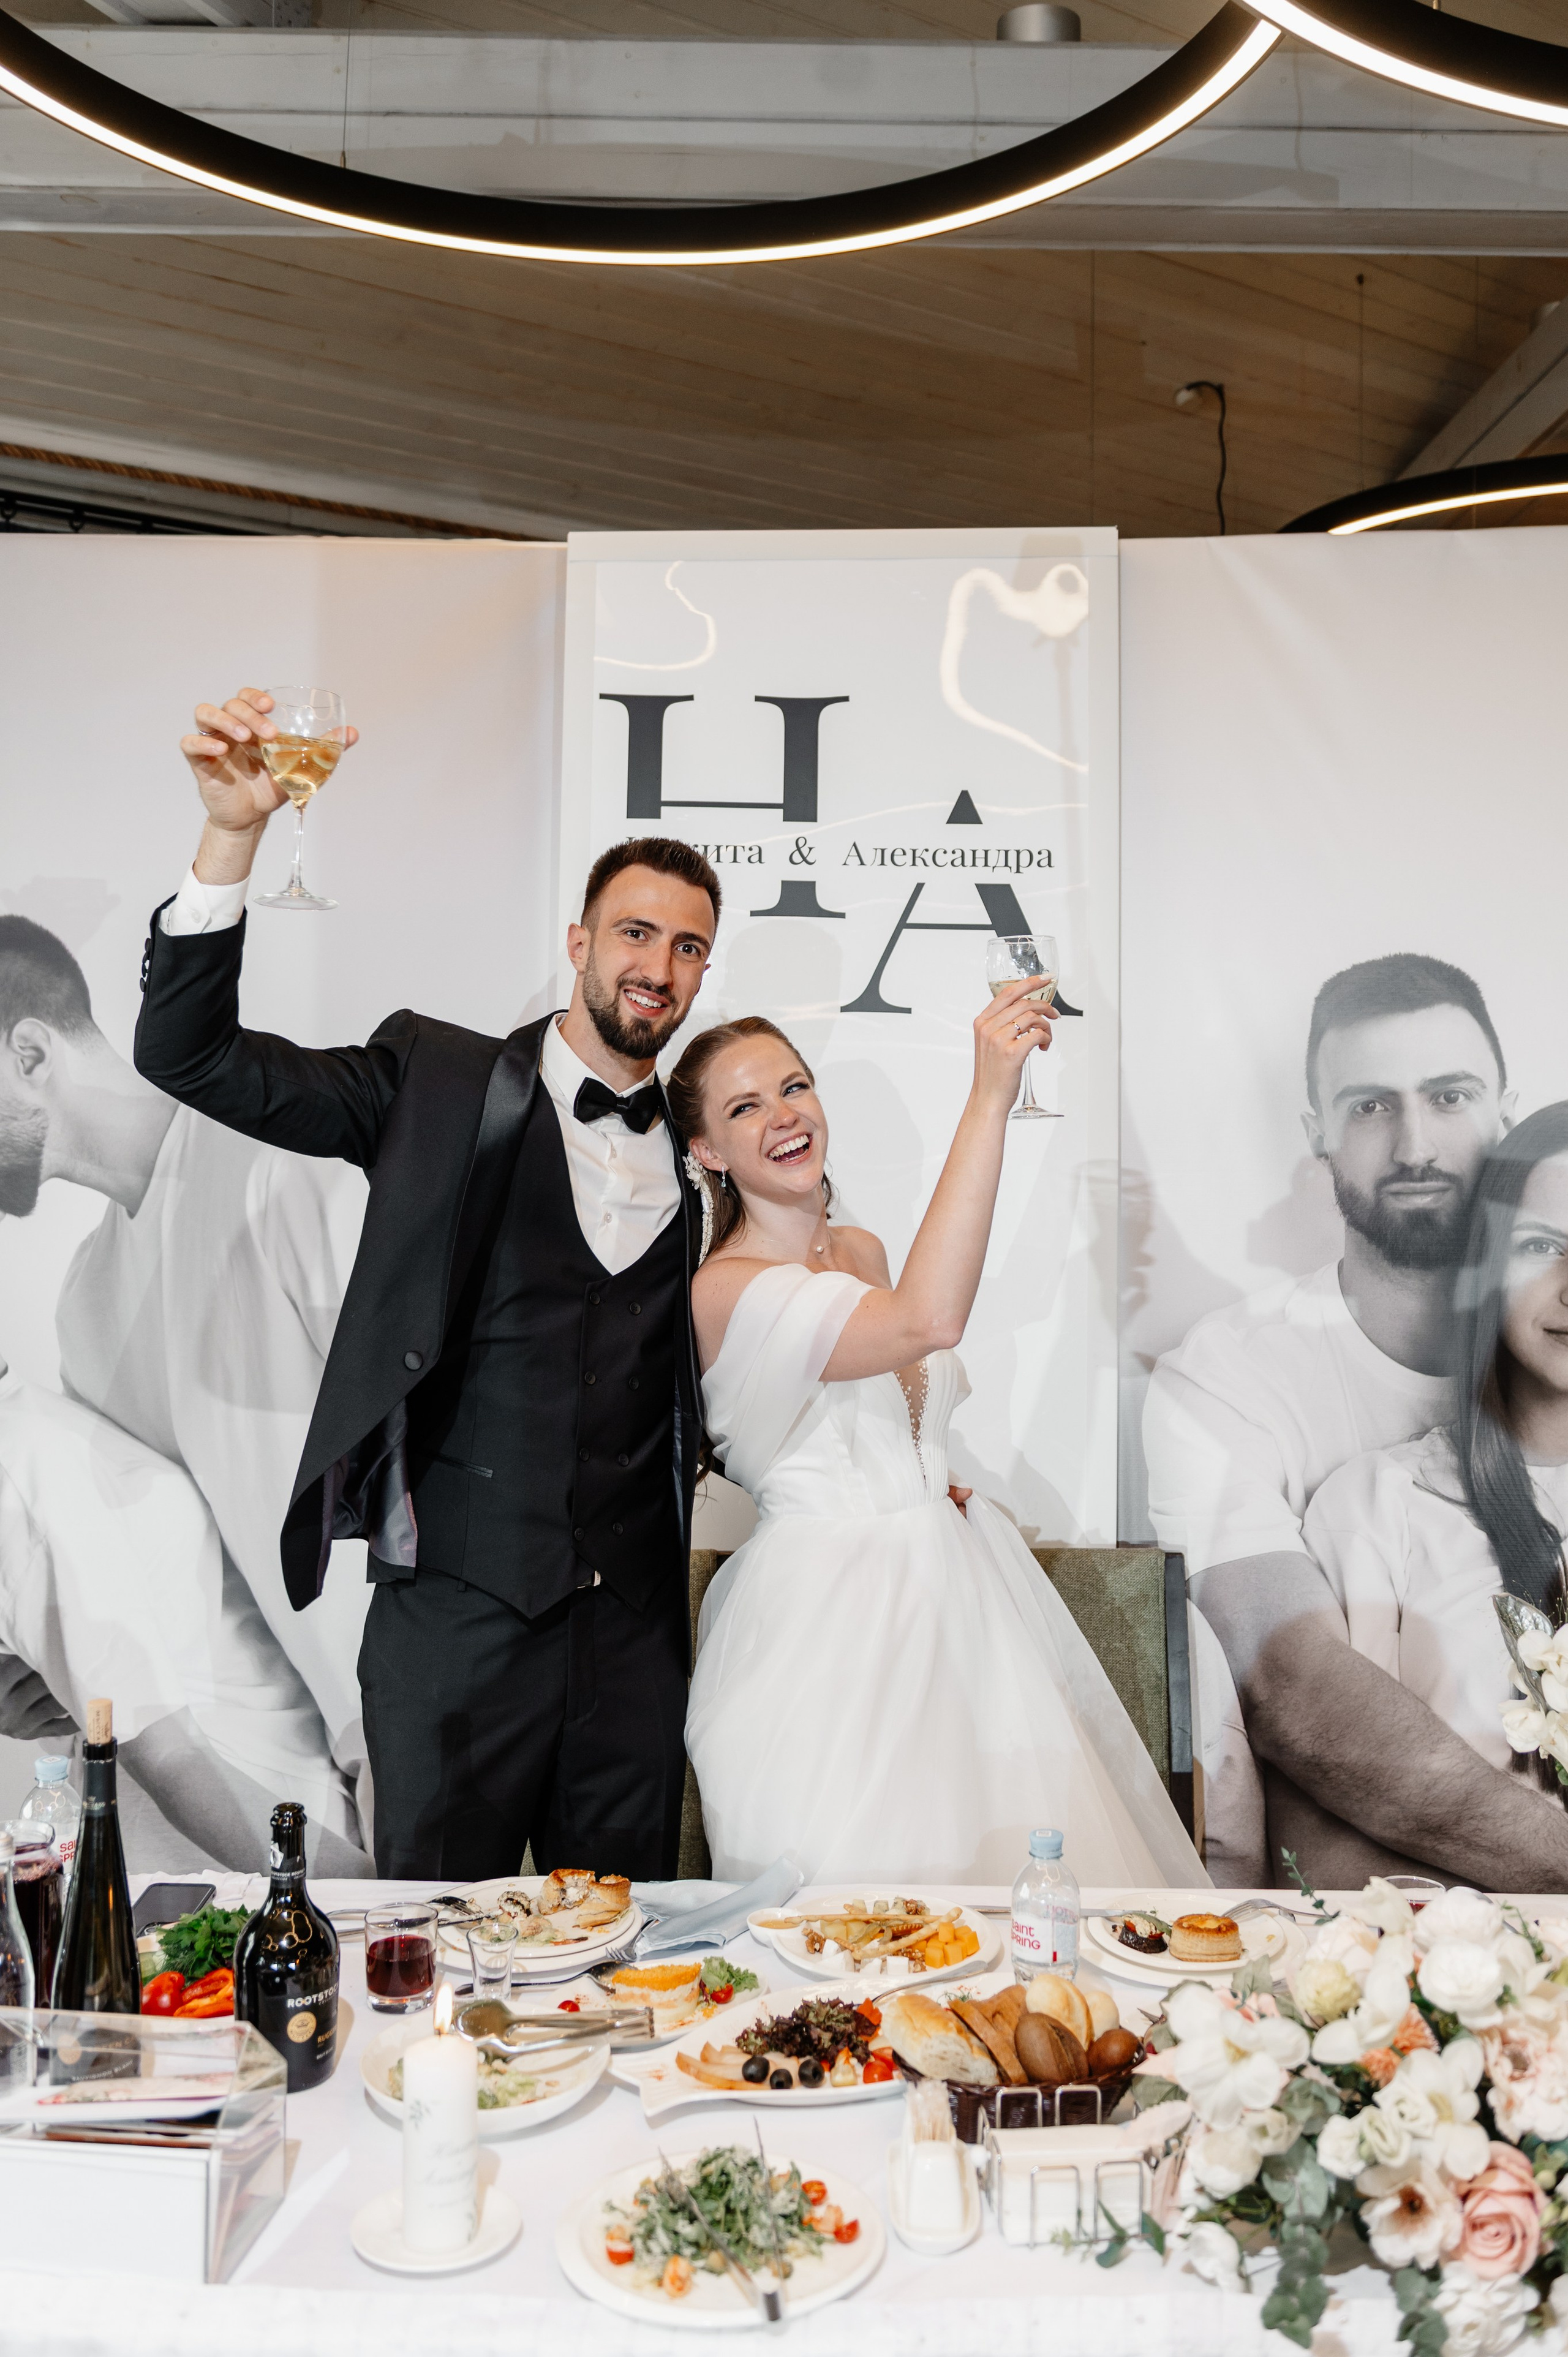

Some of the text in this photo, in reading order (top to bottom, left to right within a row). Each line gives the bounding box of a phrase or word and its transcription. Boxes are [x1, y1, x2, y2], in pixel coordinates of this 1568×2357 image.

[789, 837, 817, 865] &
[842, 841, 1055, 874] Александра
[59, 1839, 77, 1852] sai
[287, 1982, 339, 2008] ROOTSTOC
